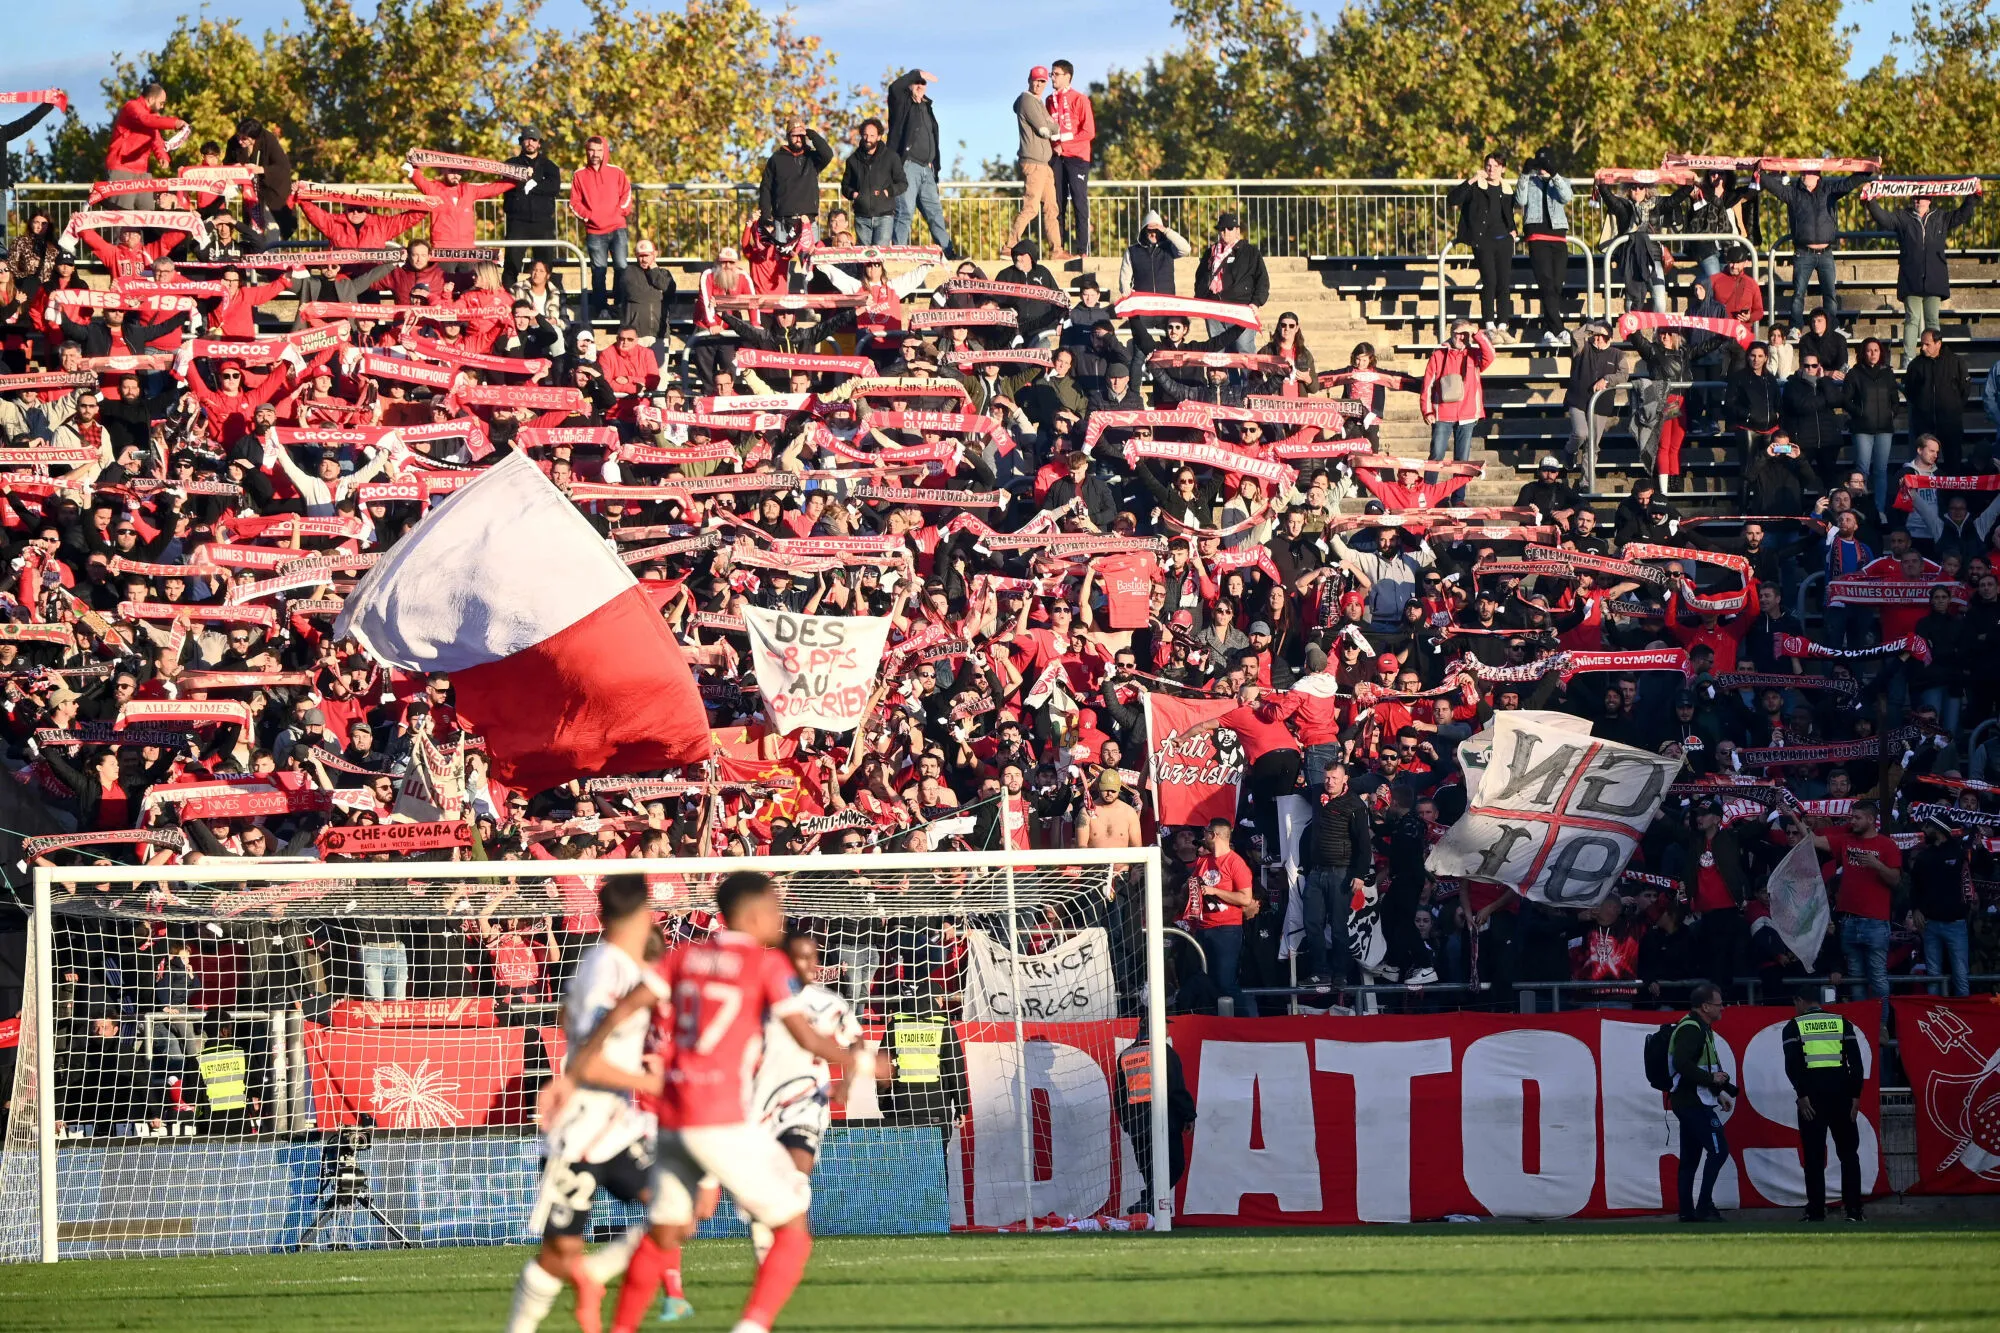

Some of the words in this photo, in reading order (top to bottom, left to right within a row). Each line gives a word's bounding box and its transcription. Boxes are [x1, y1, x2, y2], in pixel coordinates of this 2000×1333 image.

[207, 344, 270, 356] CROCOS
[903, 420, 963, 431] OLYMPIQUE
[548, 434, 595, 443] OLYMPIQUE
[1311, 440, 1371, 453] OLYMPIQUE
[16, 450, 84, 462] OLYMPIQUE
[1928, 480, 1978, 490] OLYMPIQUE
[360, 485, 419, 498] CROCOS
[1116, 576, 1150, 592] Bastide
[775, 614, 845, 648] DES
[1844, 638, 1908, 658] OLYMPIQUE
[1613, 653, 1678, 666] OLYMPIQUE
[789, 673, 829, 697] AU
[144, 703, 183, 714] ALLEZ
[188, 703, 233, 714] NIMES
[207, 798, 240, 810] NIMES
[352, 826, 380, 841] CHE
[387, 823, 451, 840] GUEVARA
[1805, 1021, 1828, 1031] STADIER
[900, 1033, 924, 1044] STADIER
